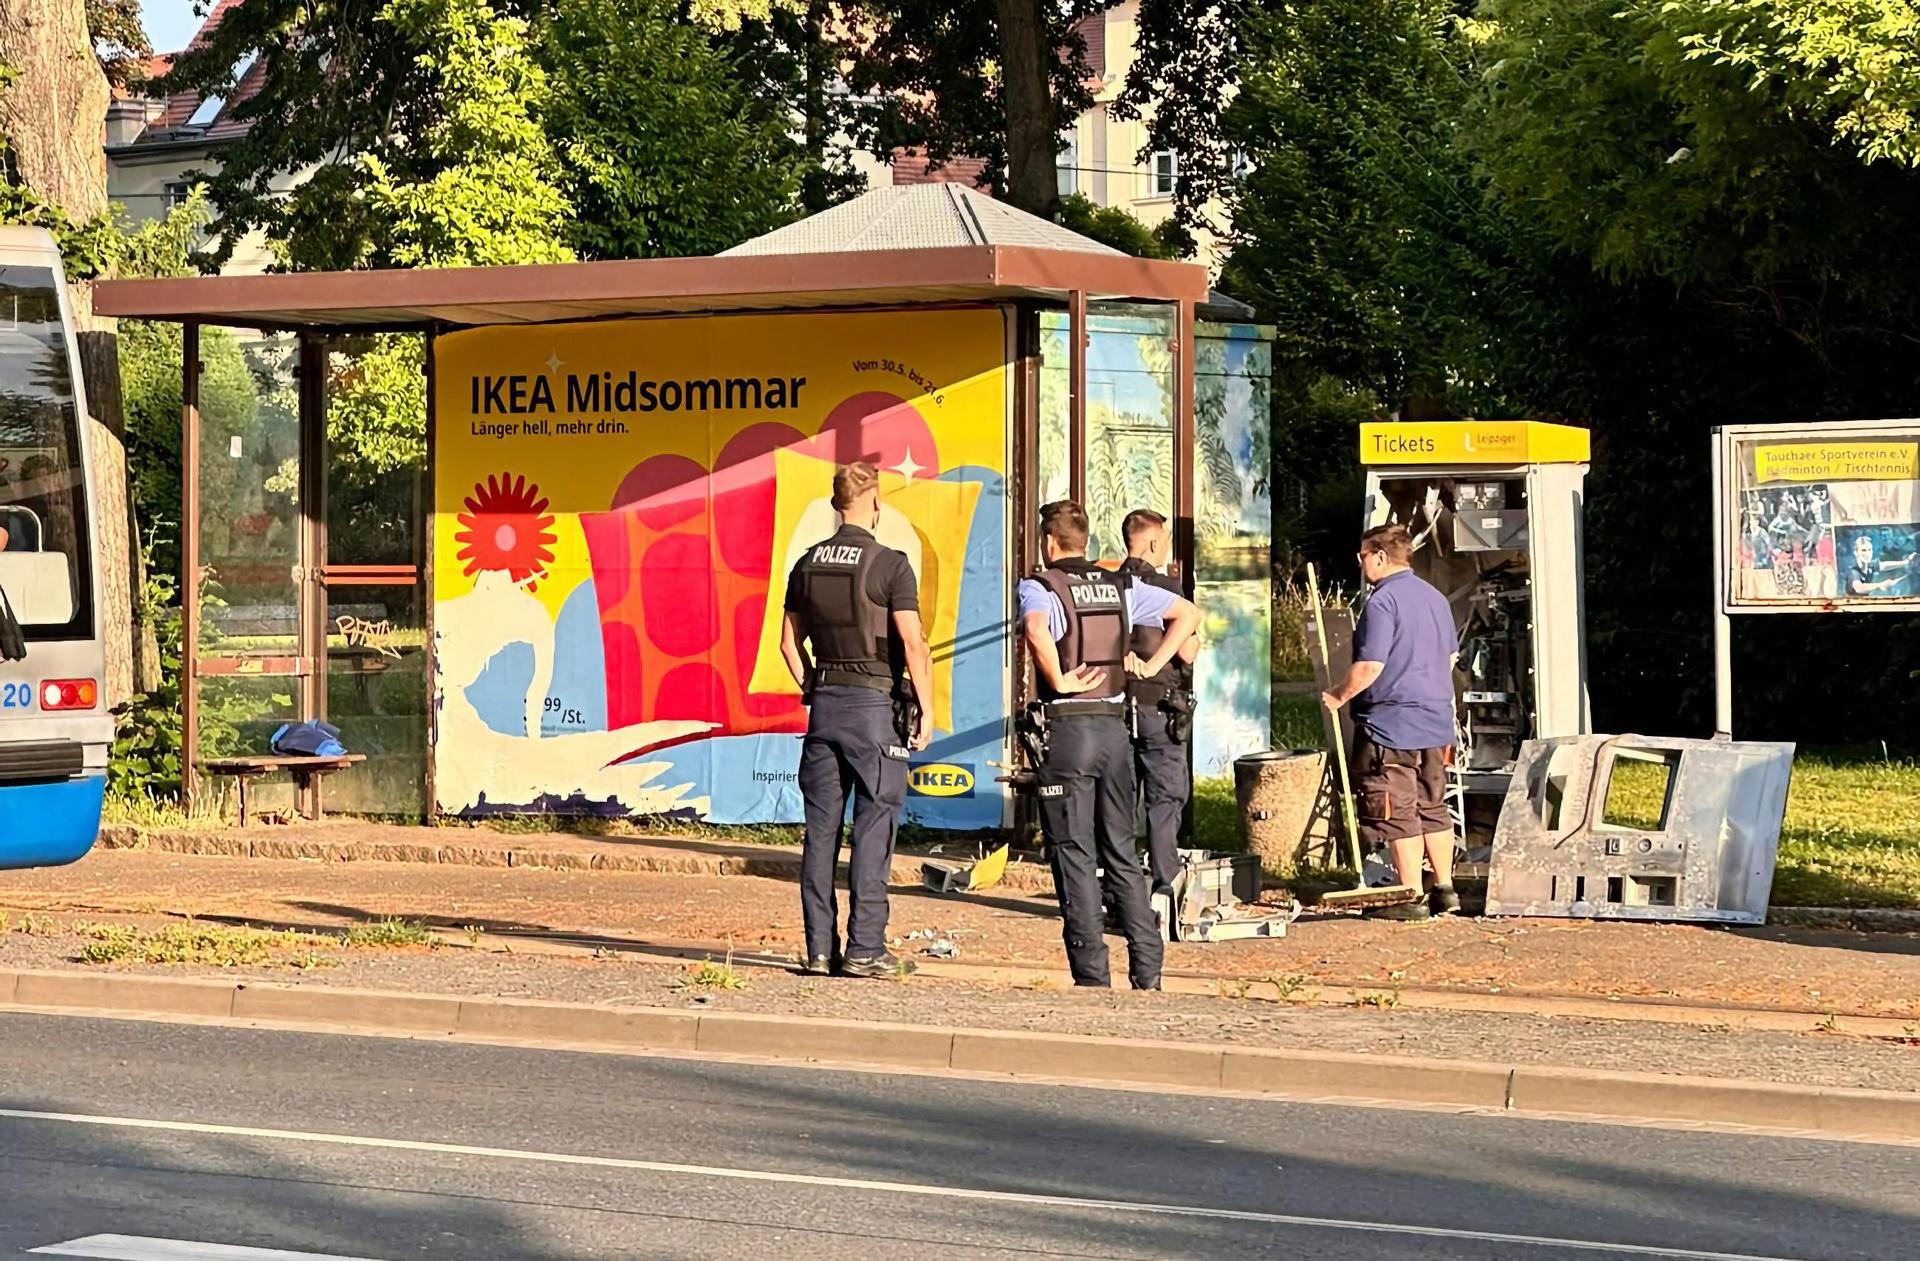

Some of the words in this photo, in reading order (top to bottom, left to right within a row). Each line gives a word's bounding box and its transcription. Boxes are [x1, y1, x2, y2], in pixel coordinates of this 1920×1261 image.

[471, 374, 556, 414] IKEA
[567, 371, 807, 413] Midsommar
[852, 360, 878, 372] Vom
[881, 359, 906, 376] 30.5.
[908, 368, 924, 386] bis
[923, 381, 945, 408] 21.6.
[471, 421, 519, 439] Länger
[522, 420, 552, 436] hell,
[556, 419, 593, 434] mehr
[596, 419, 630, 434] drin.
[1372, 434, 1435, 453] Tickets
[1766, 451, 1816, 462] Tauchaer
[1820, 449, 1887, 462] Sportverein
[1845, 463, 1911, 475] Tischtennis
[812, 545, 863, 564] POLIZEI
[1070, 584, 1121, 604] POLIZEI
[3, 683, 32, 708] 20
[752, 769, 798, 785] Inspirier
[912, 772, 969, 787] IKEA
